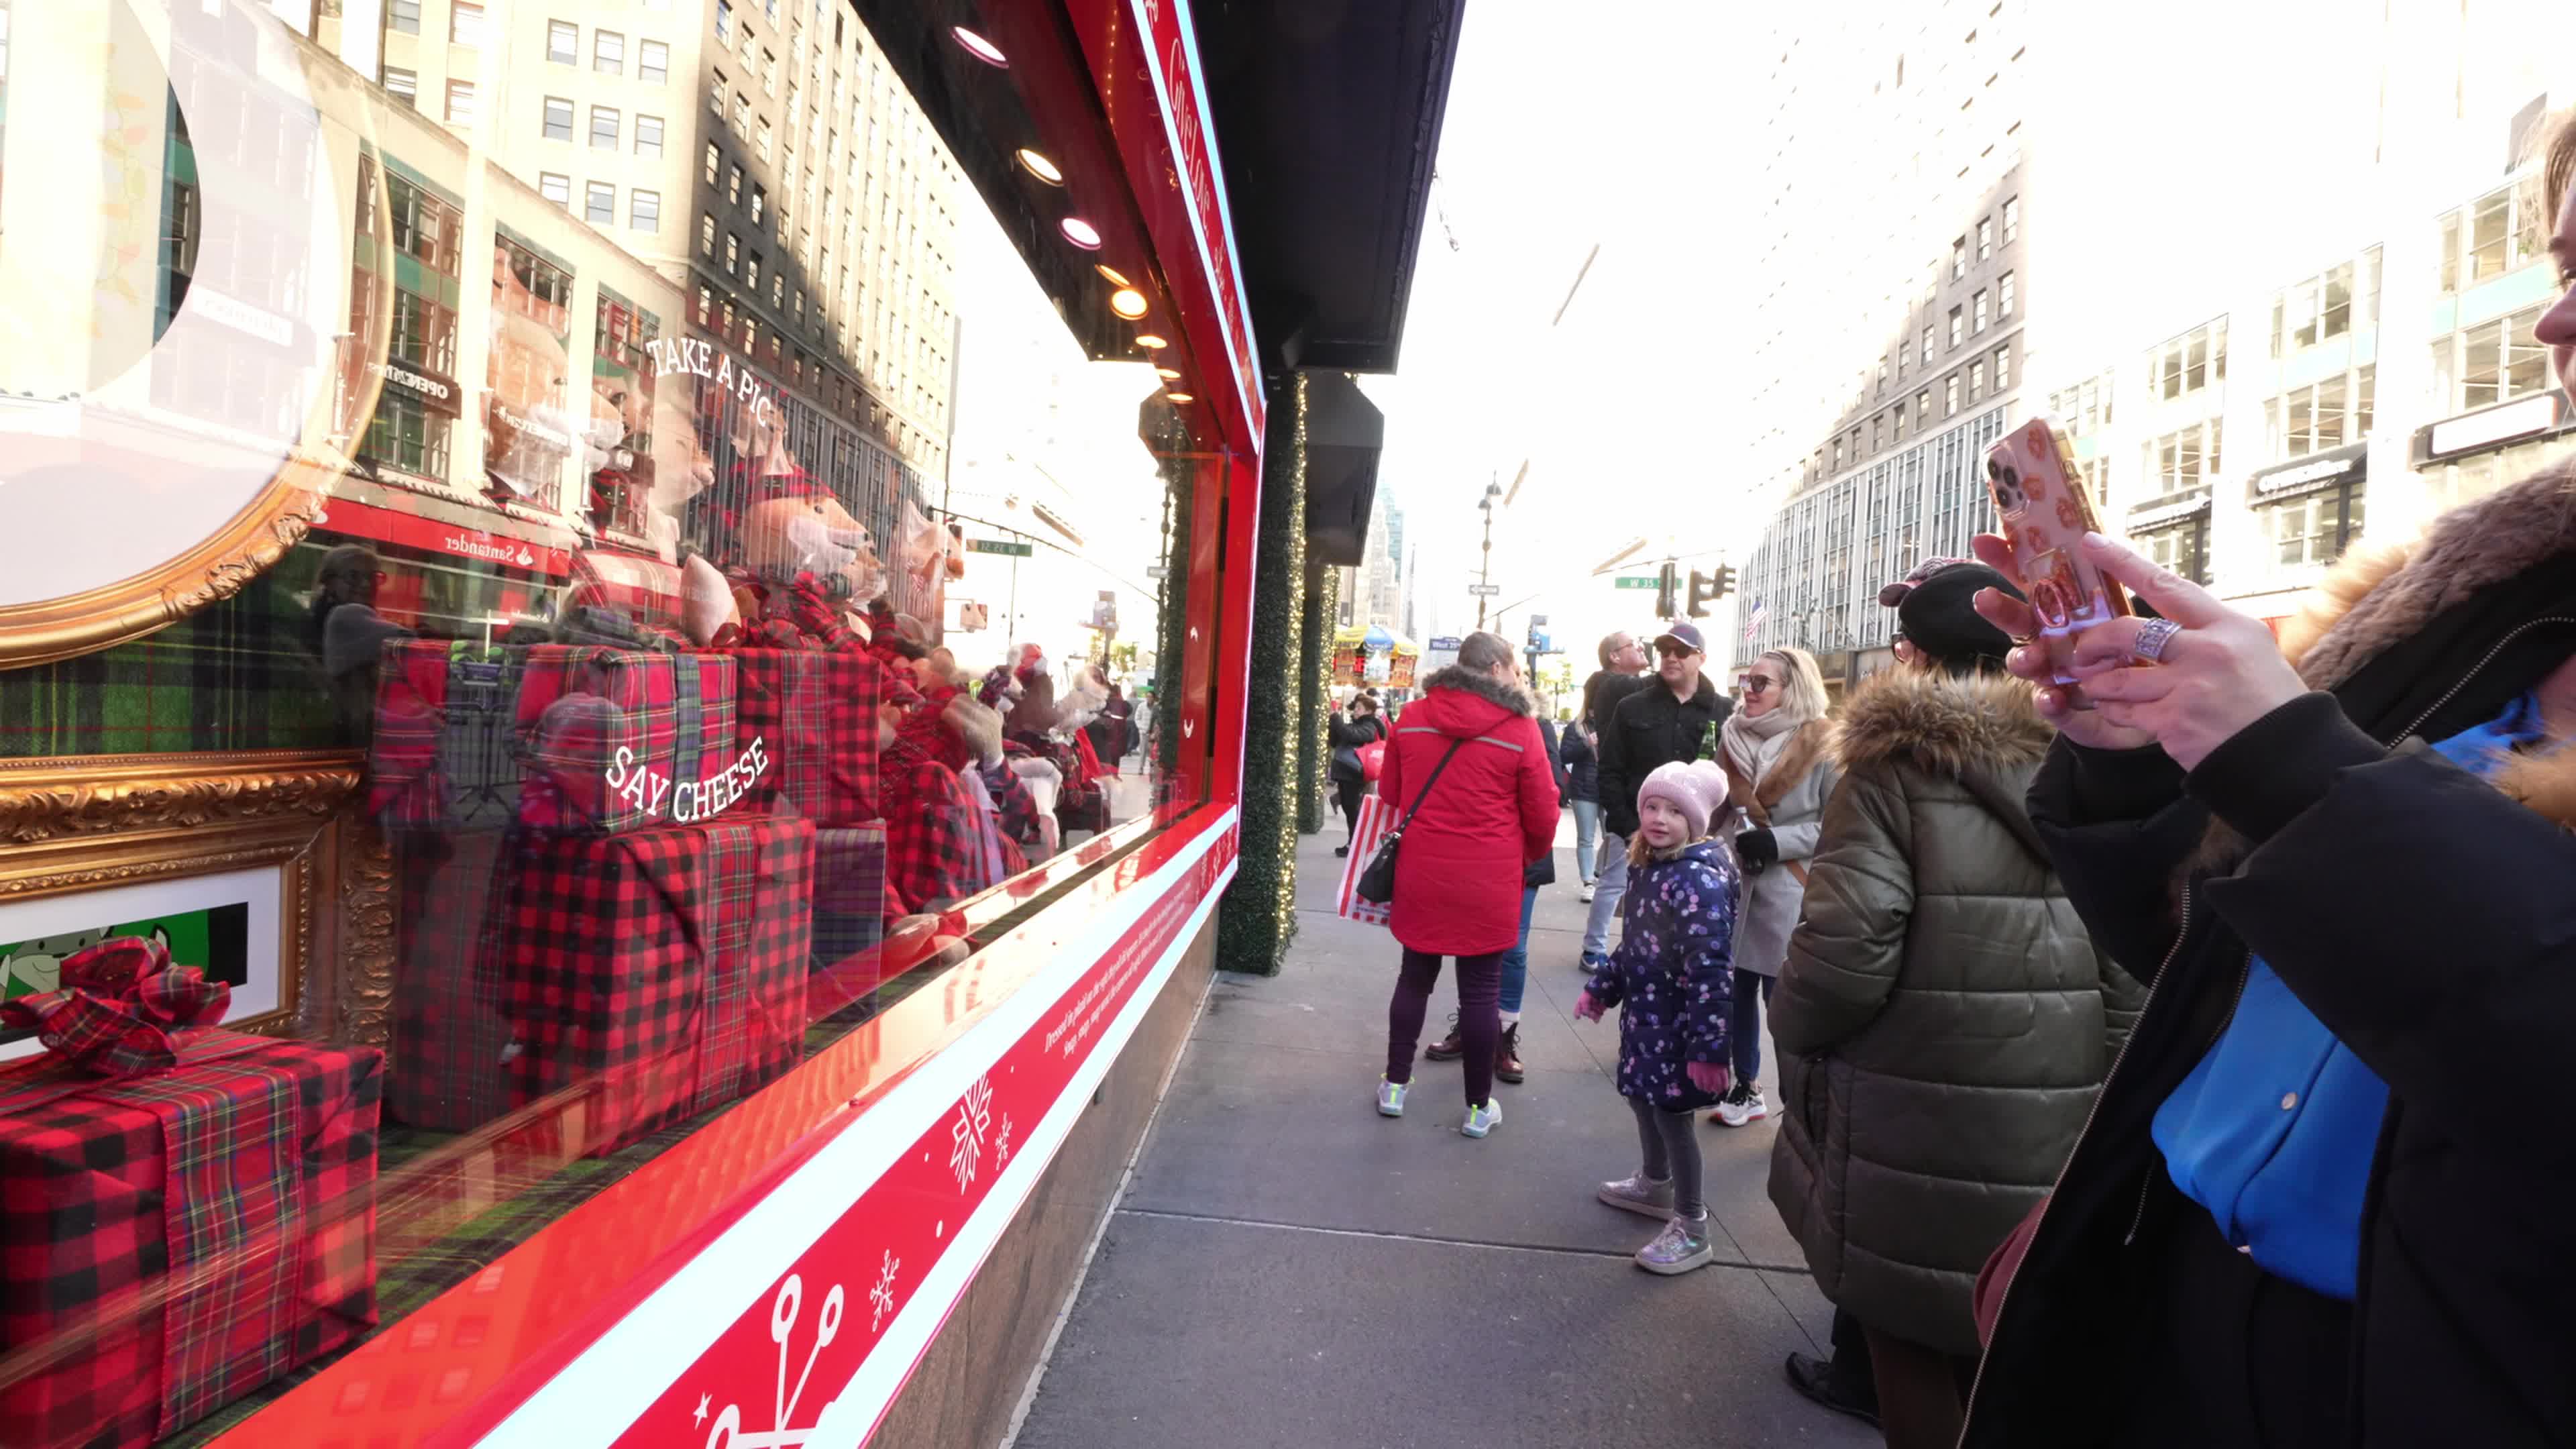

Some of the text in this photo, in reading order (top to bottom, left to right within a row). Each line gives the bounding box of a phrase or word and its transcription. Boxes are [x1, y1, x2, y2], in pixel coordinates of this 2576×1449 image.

[645, 337, 771, 427] TAKE A PIC
[1630, 579, 1639, 588] W
[605, 736, 768, 822] SAY CHEESE
